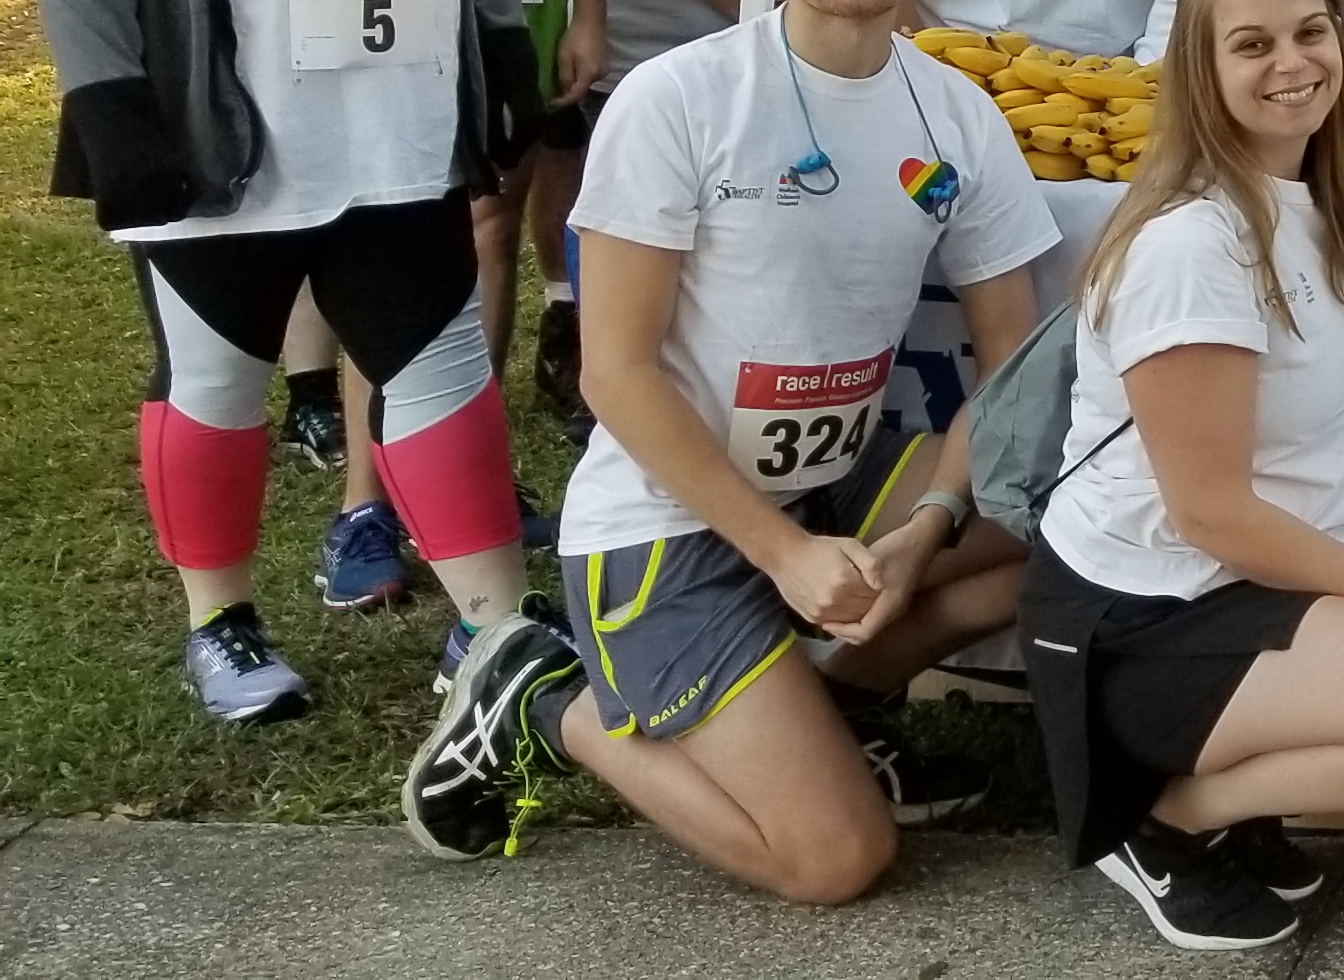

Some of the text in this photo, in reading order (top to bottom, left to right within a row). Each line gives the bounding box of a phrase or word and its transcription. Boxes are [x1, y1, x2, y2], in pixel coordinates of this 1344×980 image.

[775, 361, 879, 392] race result
[756, 404, 871, 478] 324
[649, 675, 708, 728] BALEAF
